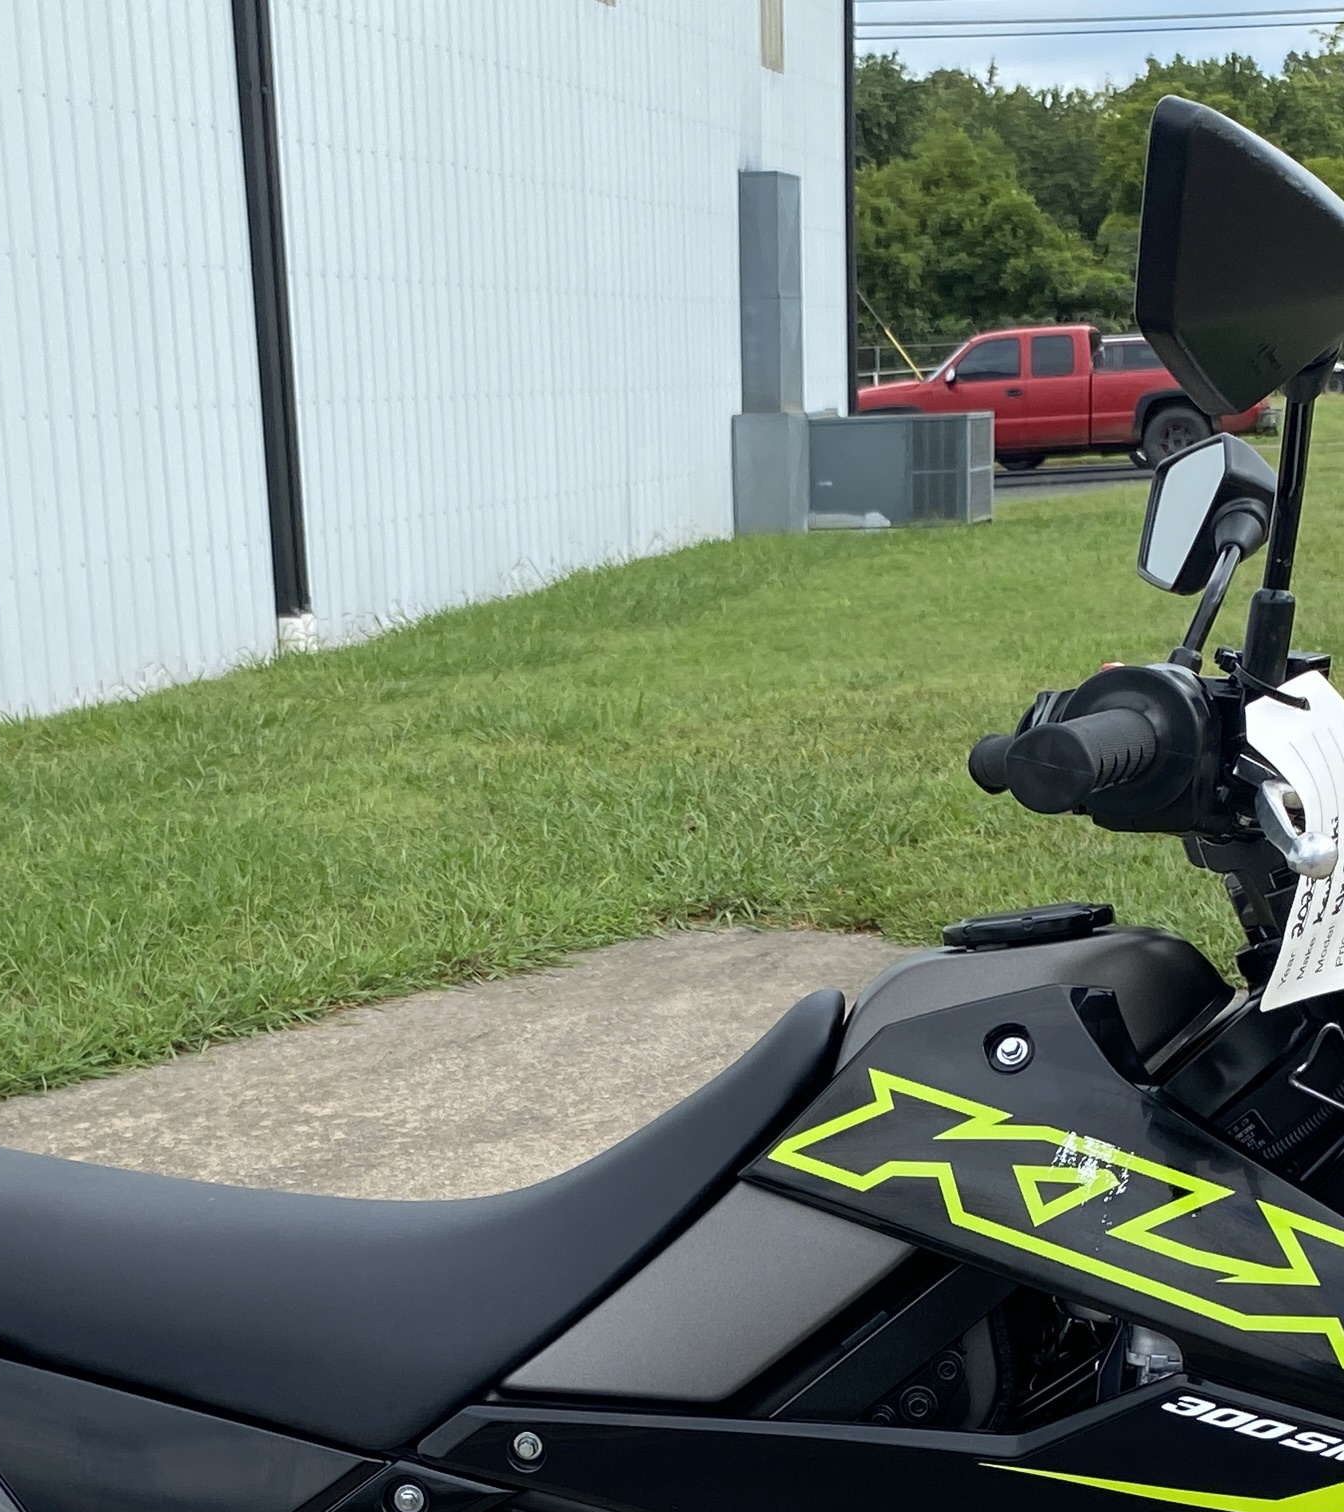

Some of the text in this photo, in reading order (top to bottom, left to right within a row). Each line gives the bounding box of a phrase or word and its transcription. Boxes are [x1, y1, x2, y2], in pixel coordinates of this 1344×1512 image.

[1277, 952, 1296, 989] Year
[1296, 936, 1317, 981] Make
[1314, 924, 1336, 974] Model
